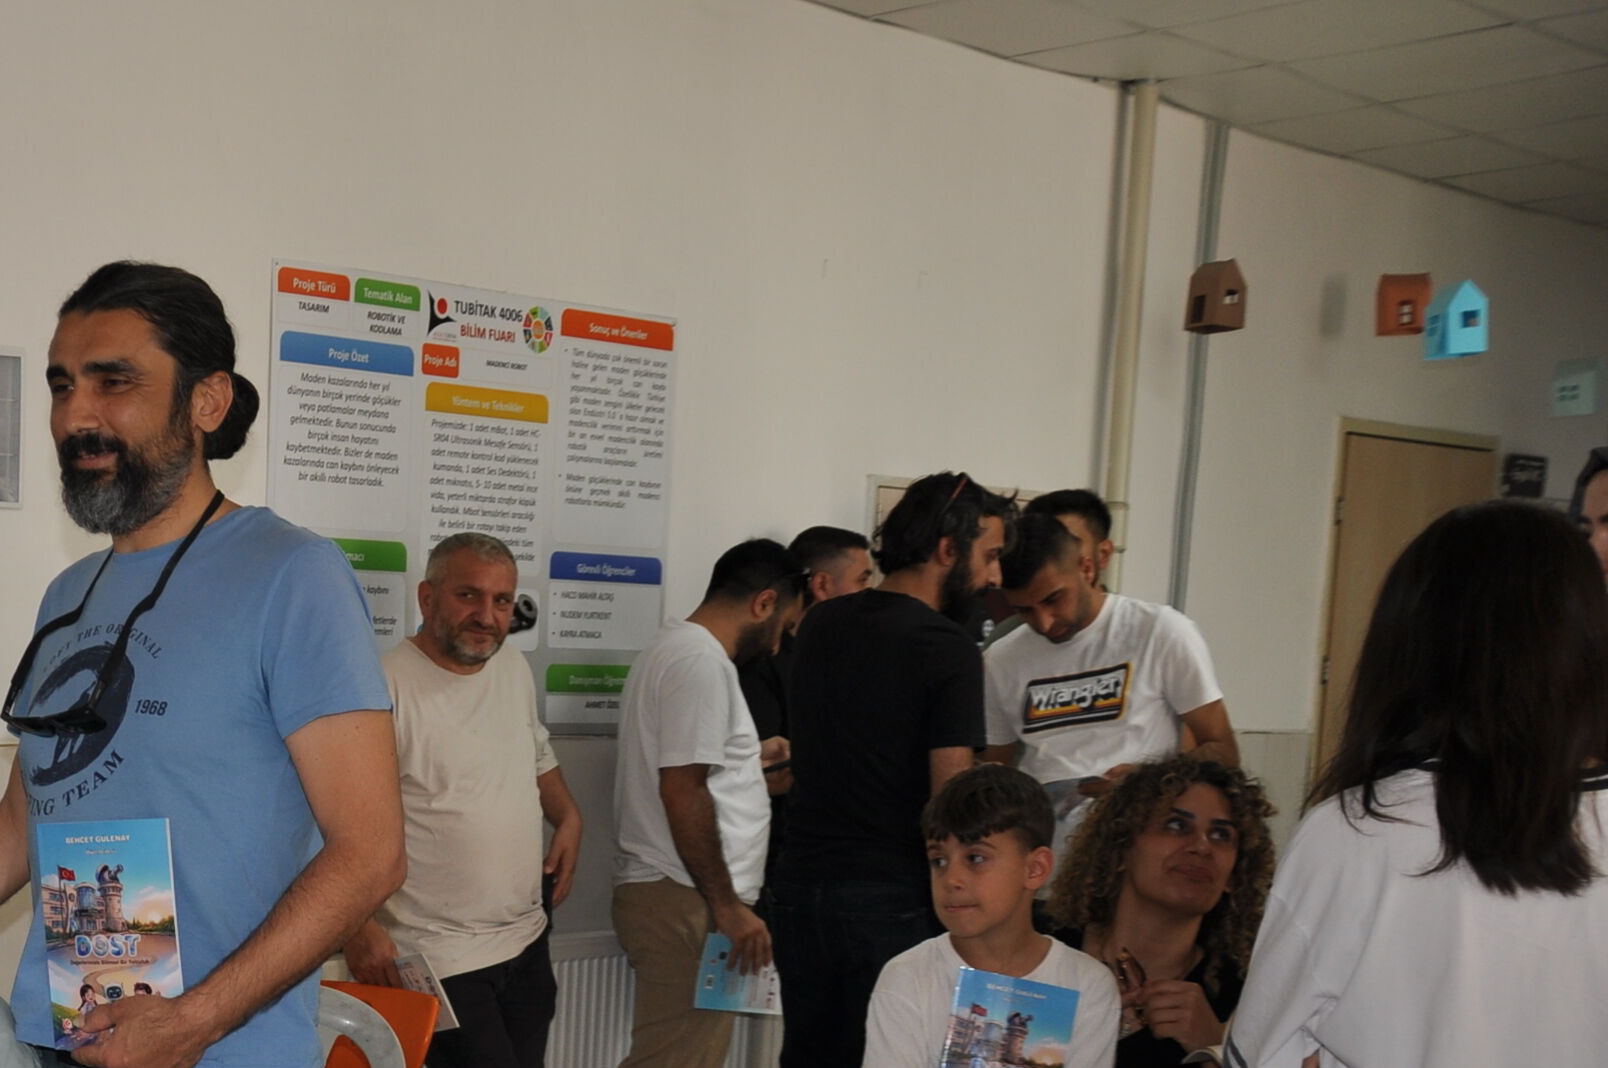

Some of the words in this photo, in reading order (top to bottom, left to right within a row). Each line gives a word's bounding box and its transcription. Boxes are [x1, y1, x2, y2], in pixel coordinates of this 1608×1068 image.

[293, 277, 316, 292] Proje
[318, 281, 336, 293] Türü
[363, 287, 393, 302] Tematik
[395, 292, 413, 304] Alan
[298, 301, 330, 313] TASARIM
[454, 300, 497, 318] TUBİTAK
[499, 308, 523, 322] 4006
[397, 315, 406, 324] VE
[369, 324, 402, 336] KODLAMA
[460, 323, 487, 339] BİLİM
[488, 329, 516, 343] FUARI
[328, 348, 350, 362] Proje
[351, 349, 369, 363] Özet
[424, 354, 441, 367] Proje
[77, 624, 102, 643] THE
[105, 623, 163, 660] ORGINAL
[1029, 676, 1123, 711] Wrangler
[135, 699, 168, 716] 1968
[62, 750, 125, 808] TEAM
[74, 932, 142, 959] DOST
